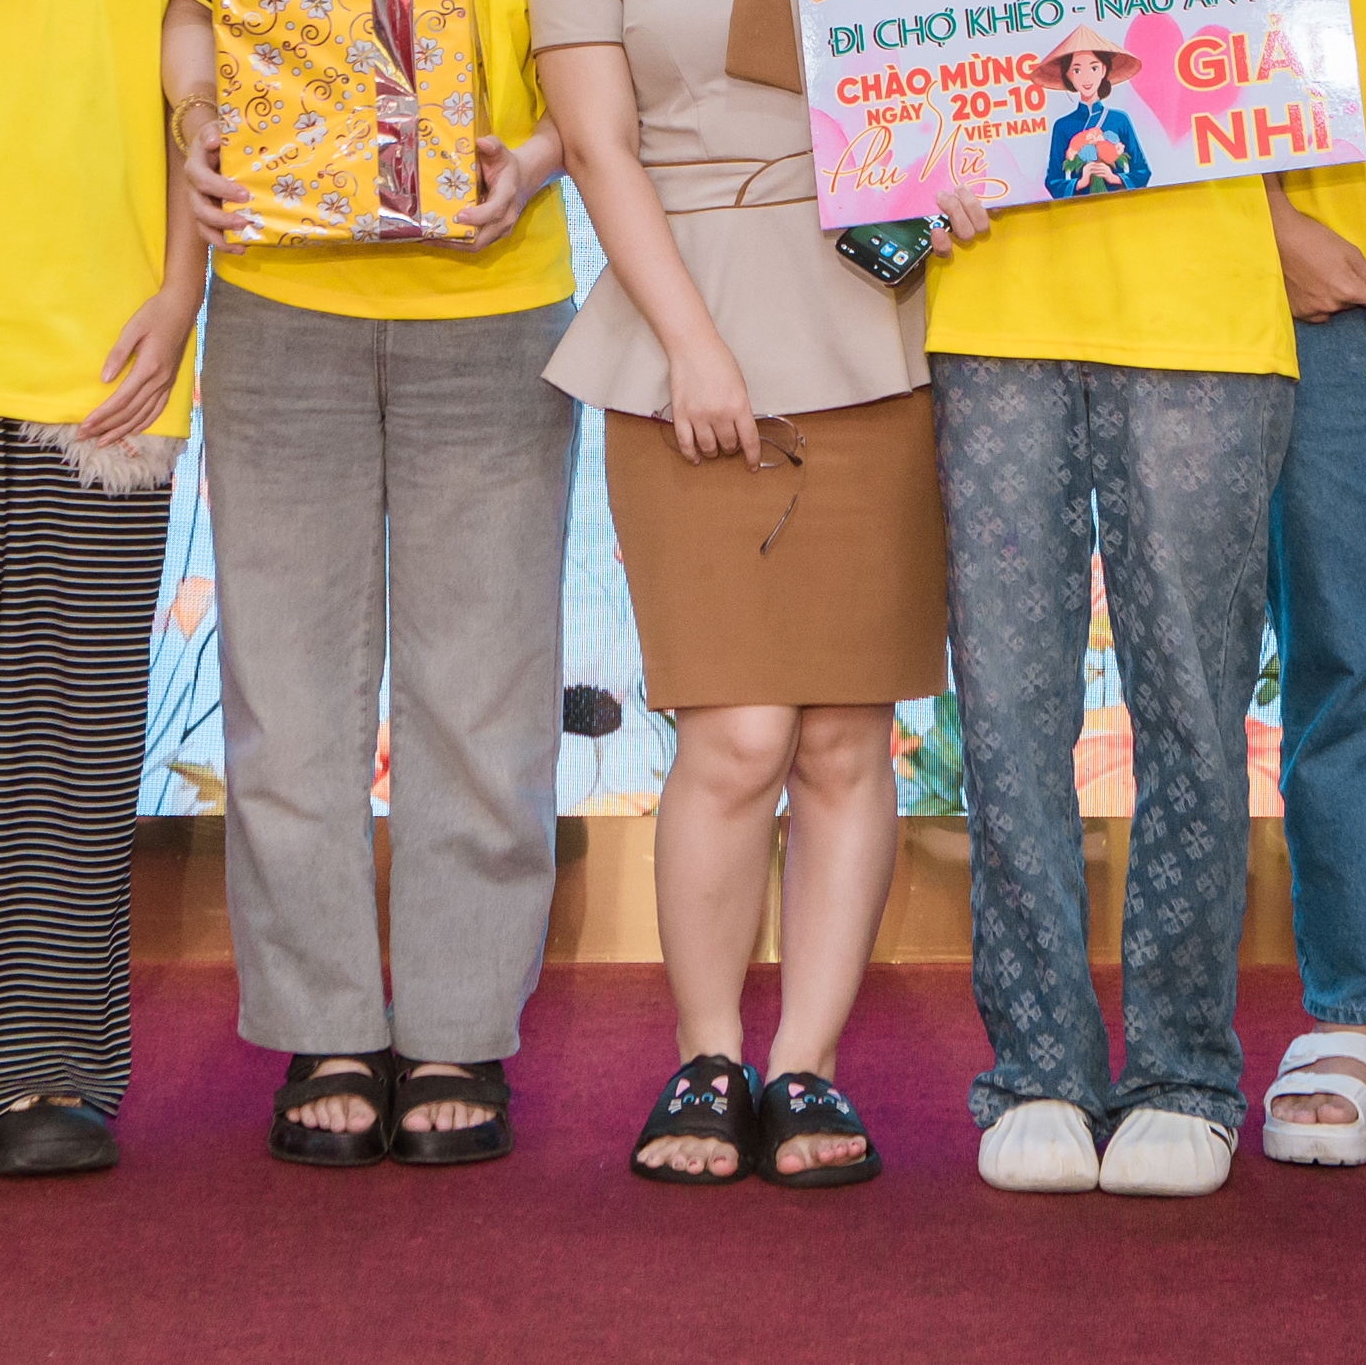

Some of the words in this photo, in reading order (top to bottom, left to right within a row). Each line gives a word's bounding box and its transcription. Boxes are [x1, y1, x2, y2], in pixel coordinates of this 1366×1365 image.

[828, 23, 866, 57] ĐI
[873, 7, 957, 50] CHỢ
[1175, 13, 1325, 91] GIẢ
[836, 64, 932, 105] CHÀO
[939, 53, 1040, 92] MỪNG
[866, 102, 924, 126] NGÀY
[949, 84, 1047, 122] 20-10
[963, 119, 1003, 144] VIỆT
[1006, 117, 1047, 135] NAM
[1191, 86, 1332, 167] NHÌ
